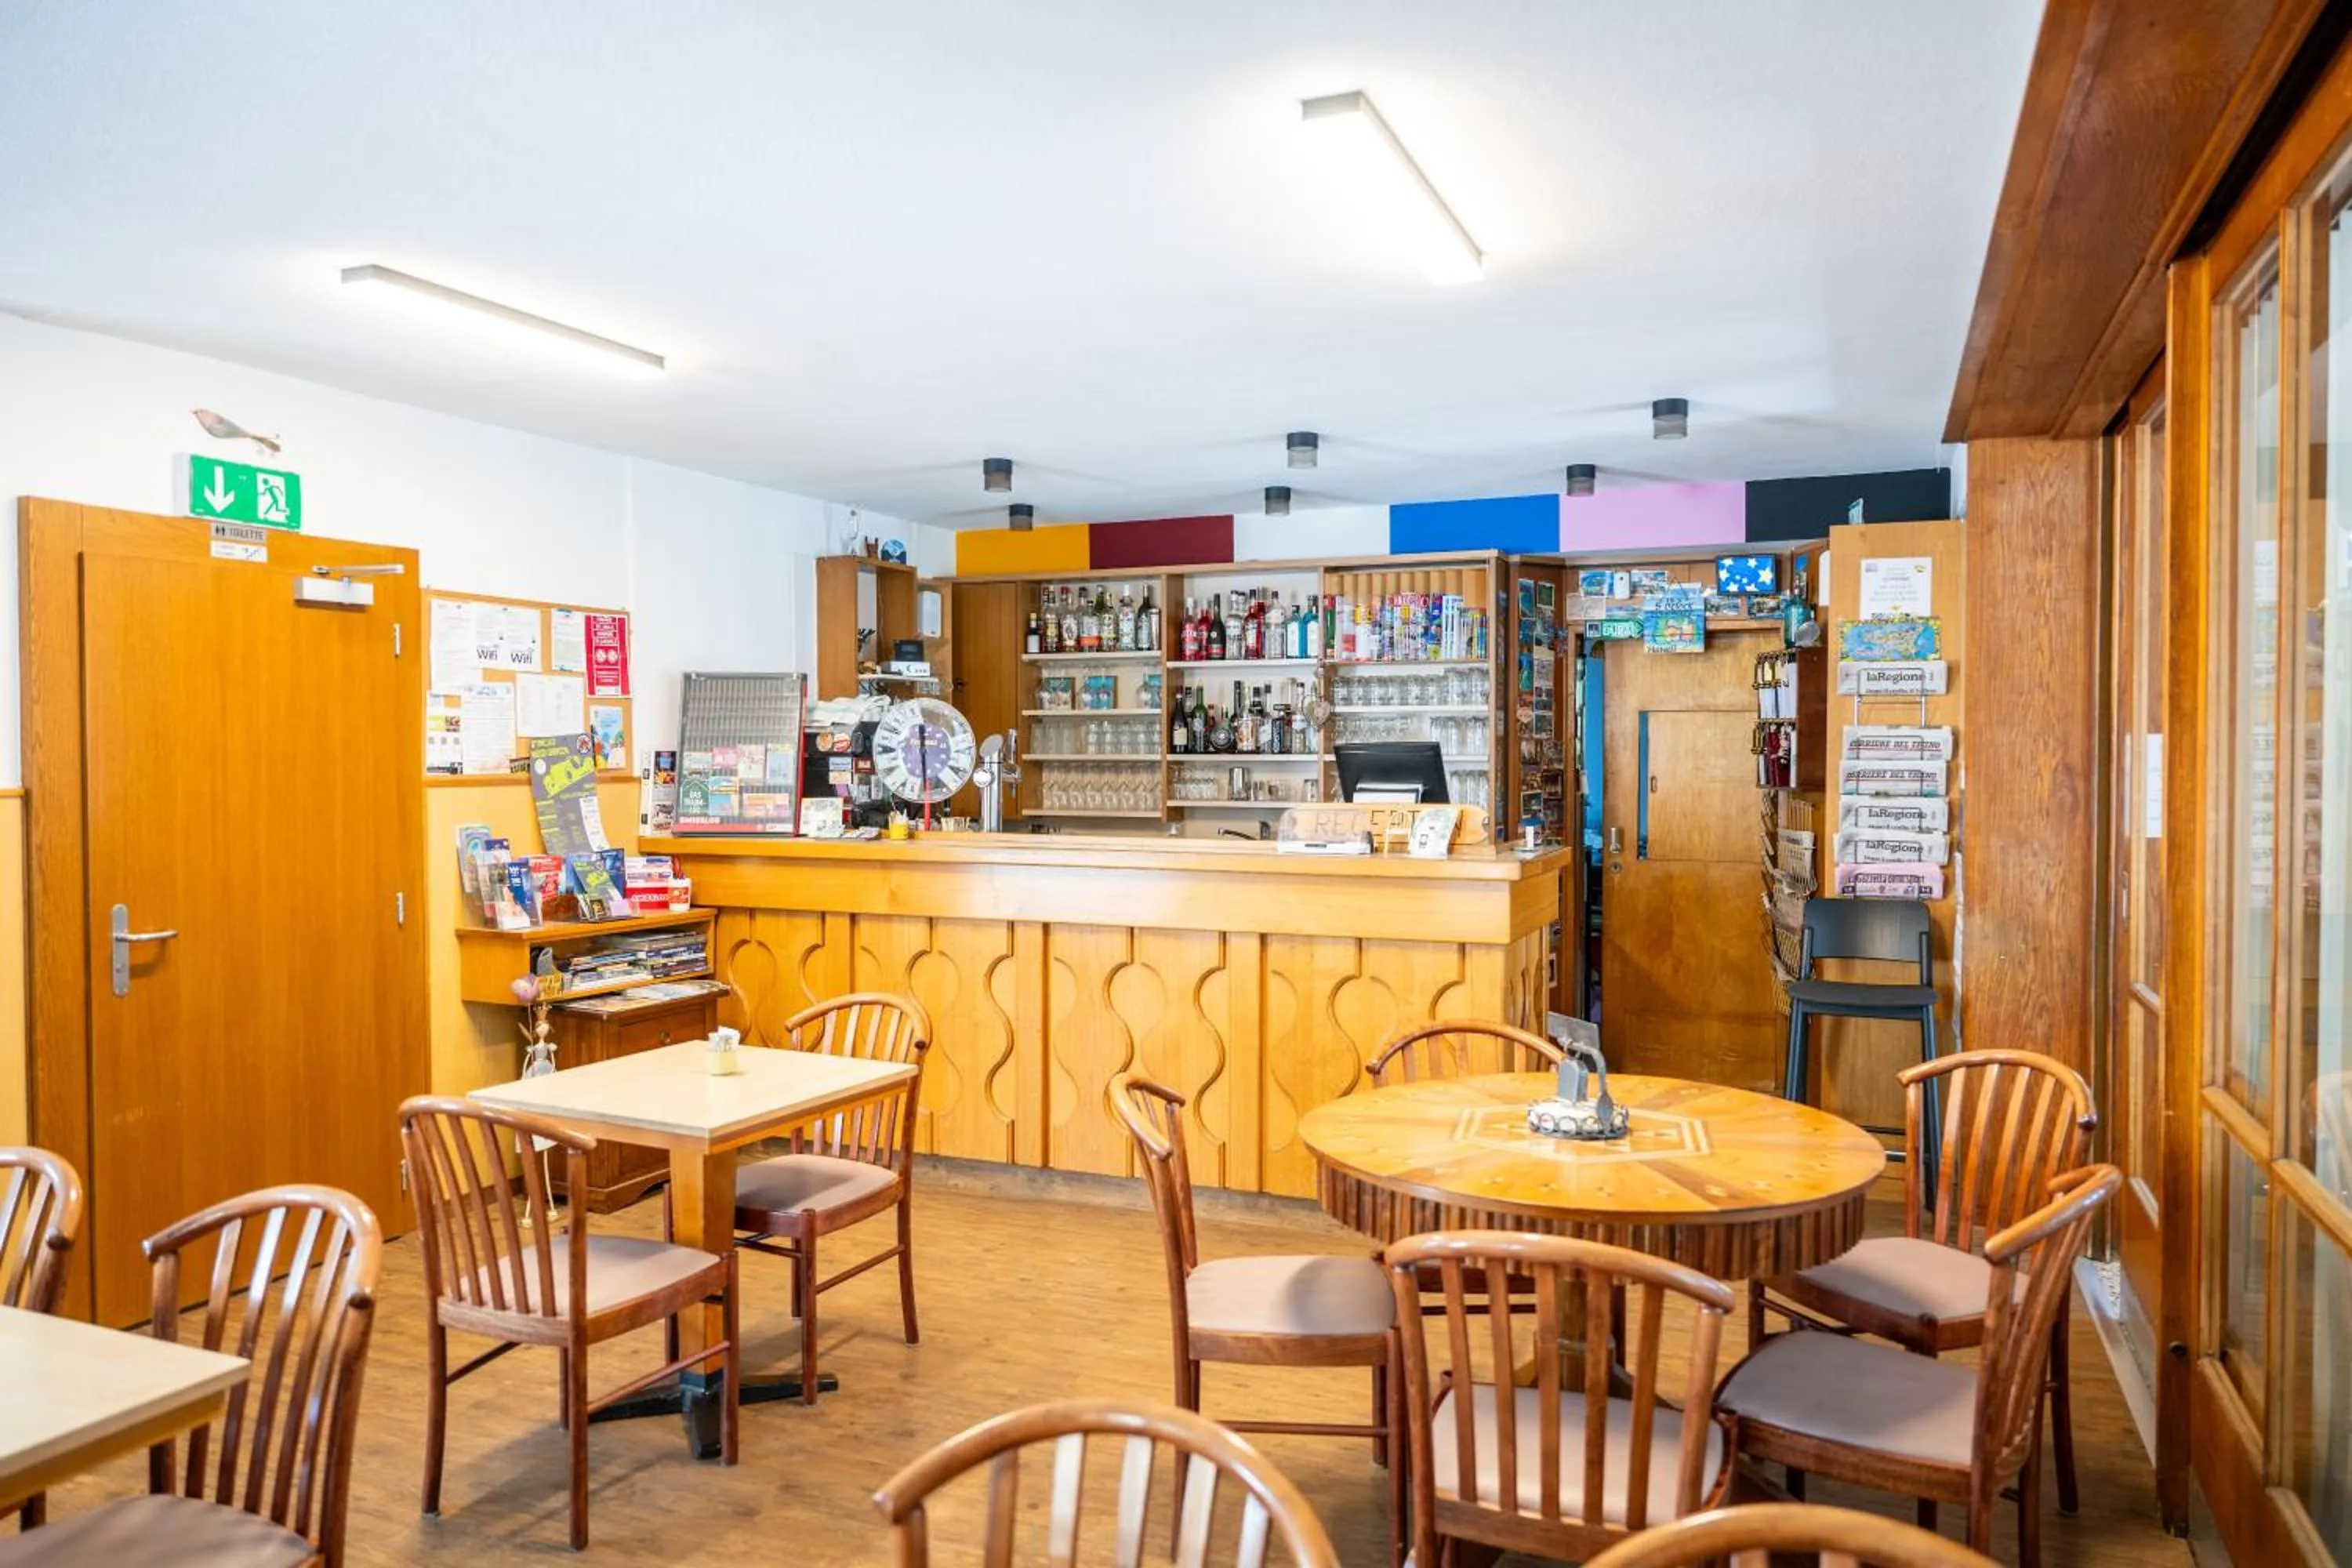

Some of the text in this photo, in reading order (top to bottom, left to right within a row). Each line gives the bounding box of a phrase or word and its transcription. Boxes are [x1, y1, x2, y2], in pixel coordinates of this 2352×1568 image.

[230, 527, 264, 541] TOILETTE
[477, 648, 499, 661] Wifi
[510, 652, 532, 664] Wifi
[1867, 672, 1926, 684] laRegione
[1868, 808, 1928, 821] laRegione
[1865, 840, 1924, 853] laRegione
